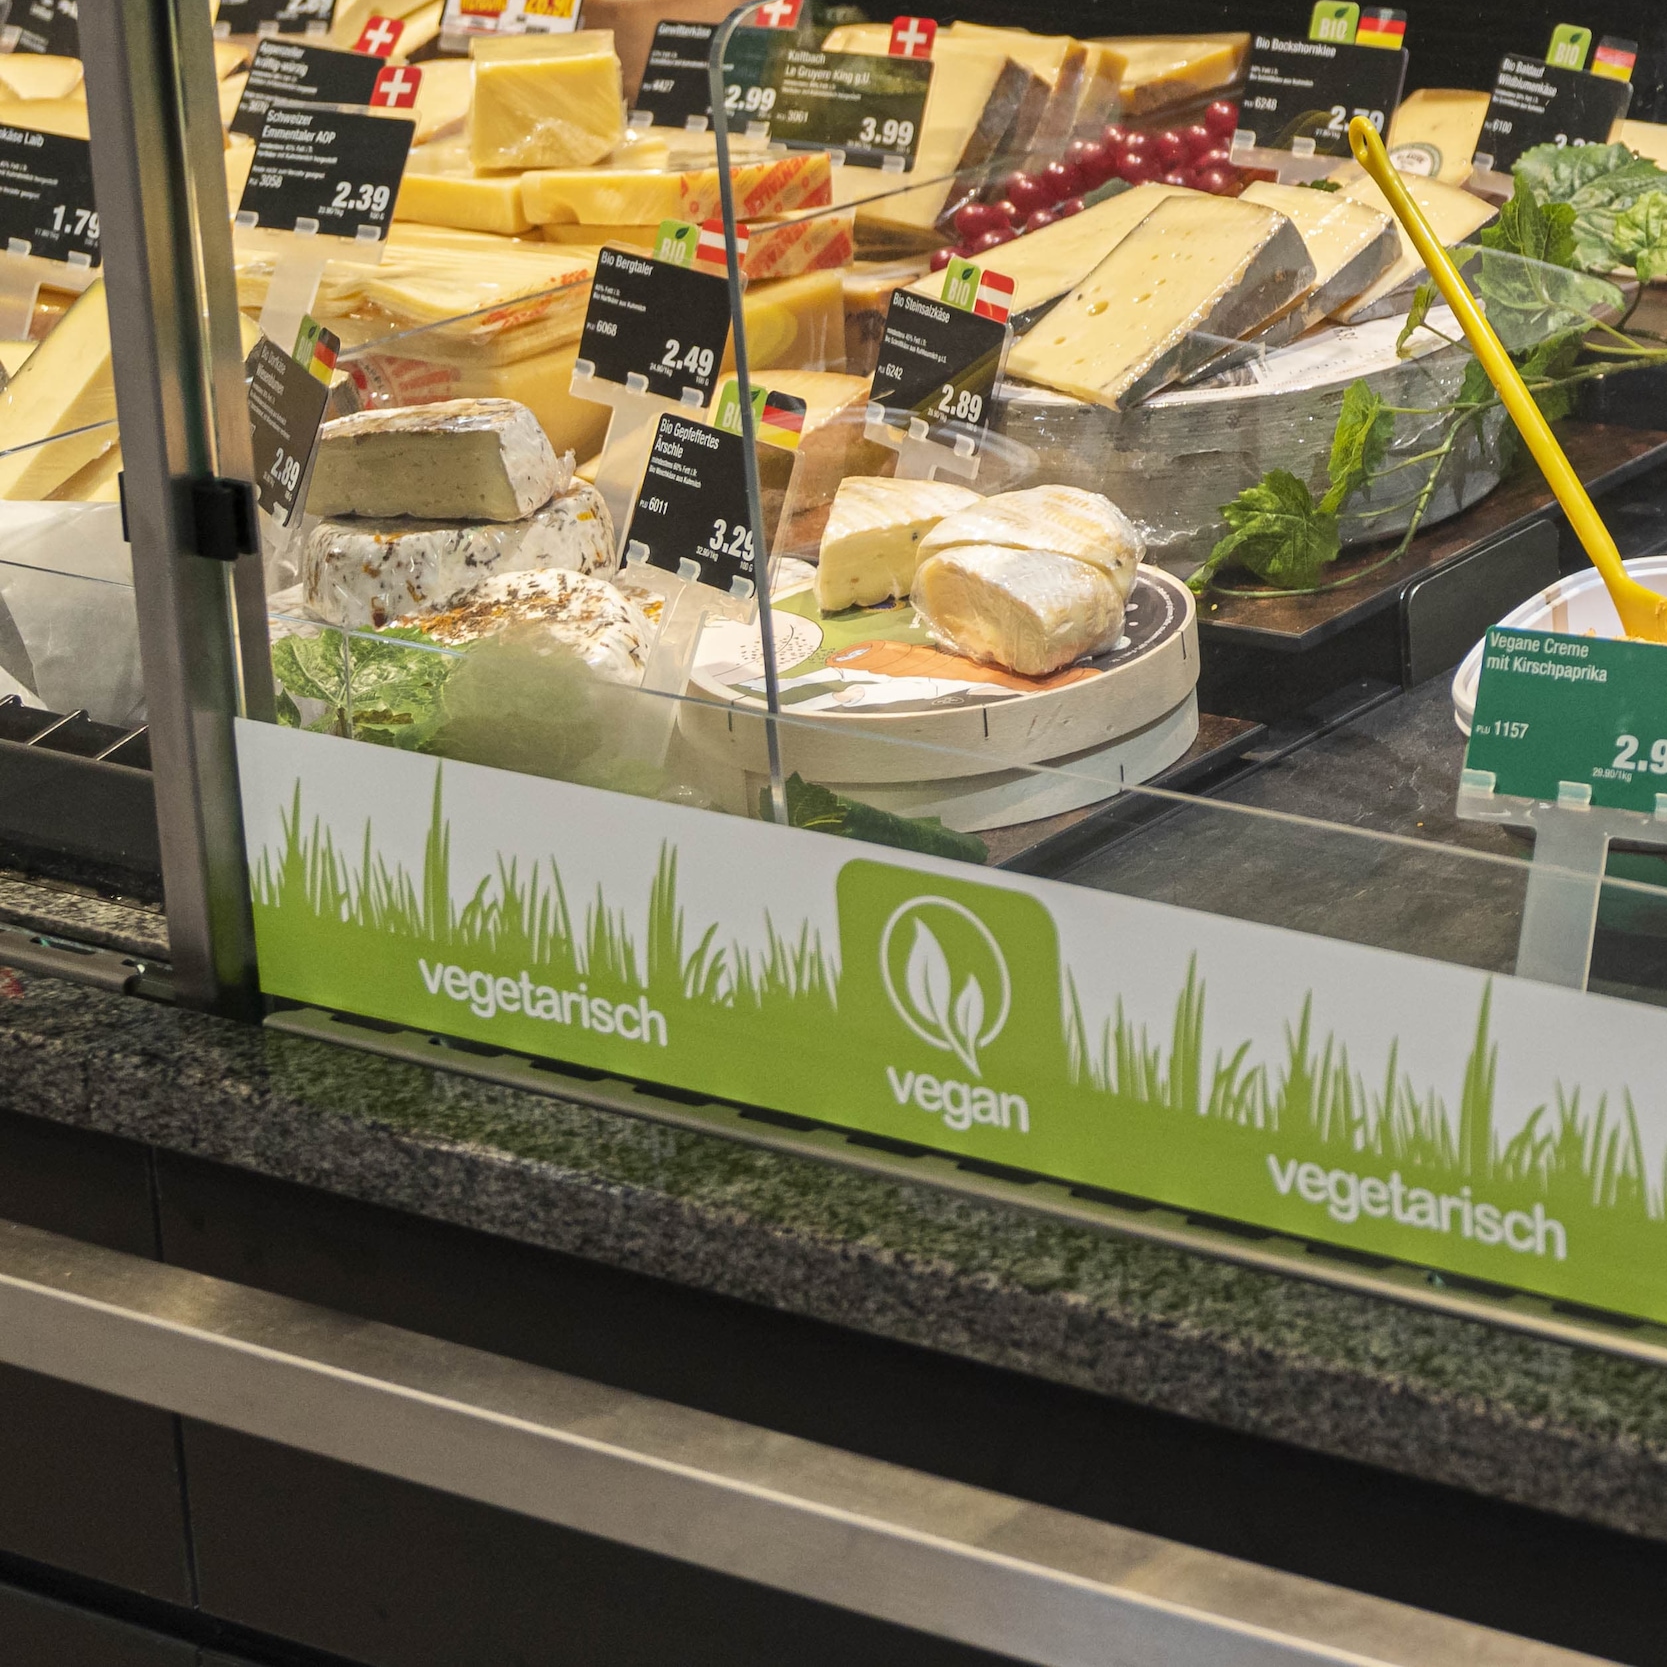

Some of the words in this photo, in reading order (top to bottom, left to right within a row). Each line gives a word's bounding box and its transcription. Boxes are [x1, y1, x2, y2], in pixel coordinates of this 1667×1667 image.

[1319, 17, 1347, 40] BIO
[788, 50, 826, 65] Kaltbach
[1255, 36, 1270, 49] Bio
[1271, 38, 1337, 58] Bockshornklee
[1555, 42, 1580, 66] BIO
[785, 66, 799, 77] Le
[832, 69, 853, 84] King
[1502, 58, 1516, 70] Bio
[725, 84, 777, 111] 2.99
[1498, 73, 1558, 98] Wildblumenkäse
[1255, 96, 1278, 111] 6248
[266, 109, 313, 126] Schweizer
[261, 125, 316, 142] Emmentaler
[315, 131, 336, 144] AOP
[859, 116, 914, 147] 3.99
[331, 181, 390, 212] 2.39
[53, 204, 100, 239] 1.79
[660, 237, 687, 263] BIO
[601, 250, 614, 266] Bio
[615, 255, 654, 277] Bergtaler
[947, 278, 970, 306] BIO
[893, 292, 905, 308] Bio
[905, 296, 950, 323] Steinsalzkäse
[596, 319, 618, 337] 6068
[662, 338, 714, 377] 2.49
[886, 363, 903, 380] 6242
[938, 384, 982, 424] 2.89
[660, 418, 673, 434] Bio
[674, 422, 719, 450] Gepfeffertes
[270, 447, 300, 492] 2.89
[648, 496, 668, 515] 6011
[709, 518, 756, 563] 3.29
[1490, 632, 1541, 653] Vegane
[1543, 637, 1590, 658] Creme
[1486, 656, 1509, 671] mit
[1512, 657, 1608, 682] Kirschpaprika
[1476, 724, 1490, 734] PLU
[1494, 720, 1529, 739] 1157
[1592, 767, 1632, 782] 29.90/1kg
[417, 958, 669, 1048] vegetarisch
[886, 1066, 1030, 1134] vegan
[1266, 1152, 1570, 1262] vegetarisch
